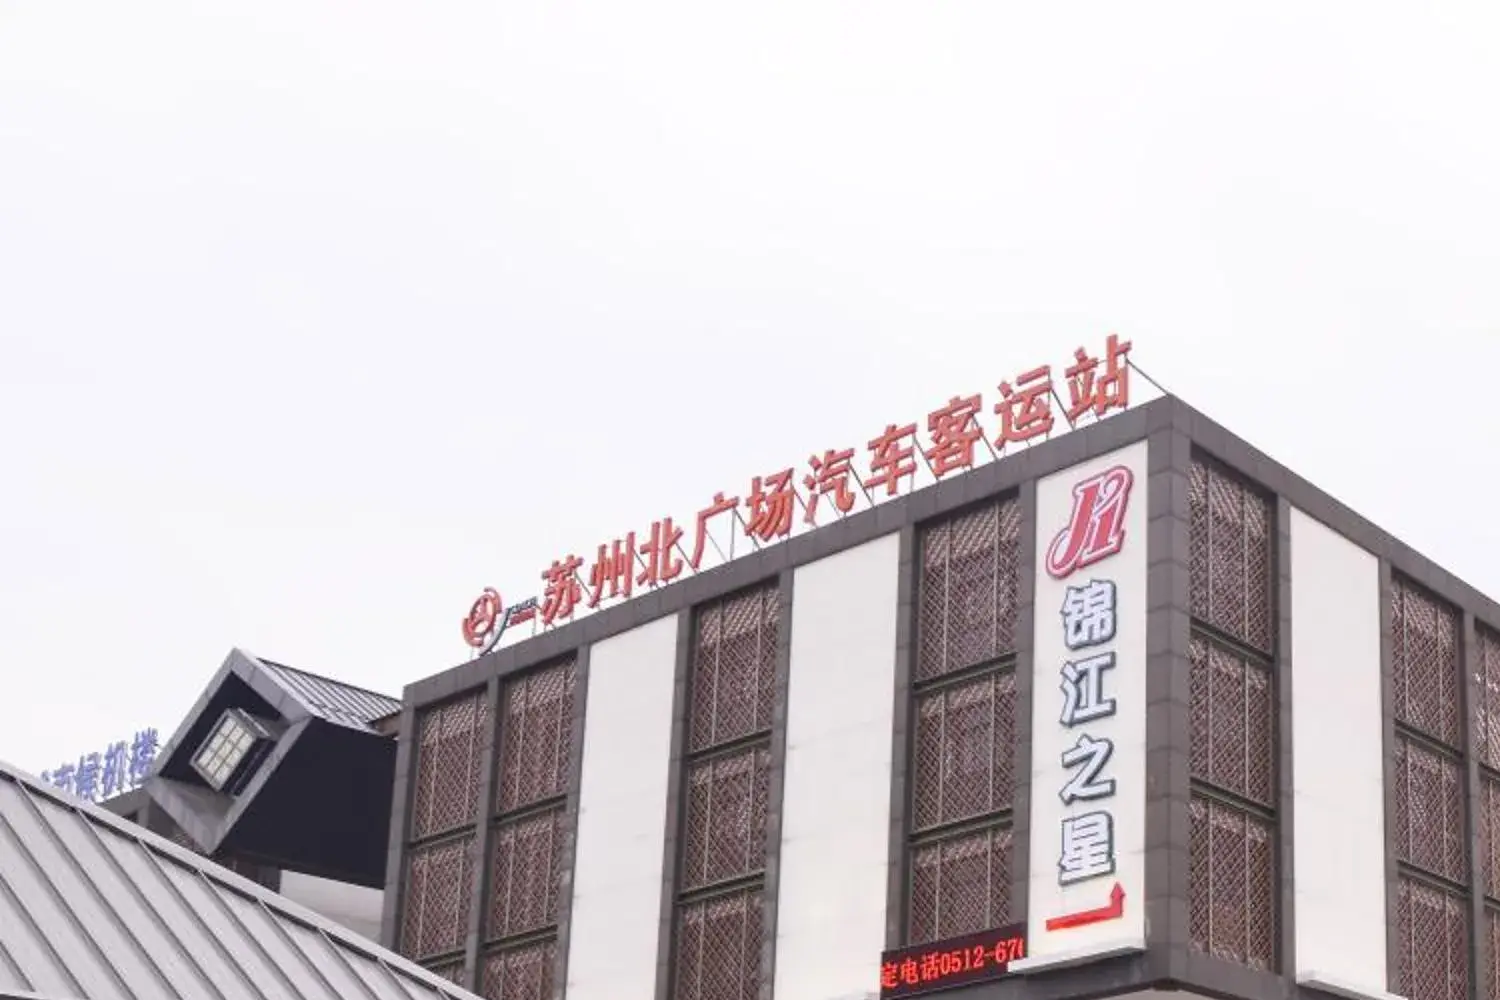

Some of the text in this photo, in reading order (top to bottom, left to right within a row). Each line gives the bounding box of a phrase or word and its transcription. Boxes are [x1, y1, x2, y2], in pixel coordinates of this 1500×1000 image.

[538, 335, 1131, 625] 苏州北广场汽车客运站
[41, 727, 158, 800] 市候机楼
[1058, 578, 1117, 885] 锦江之星
